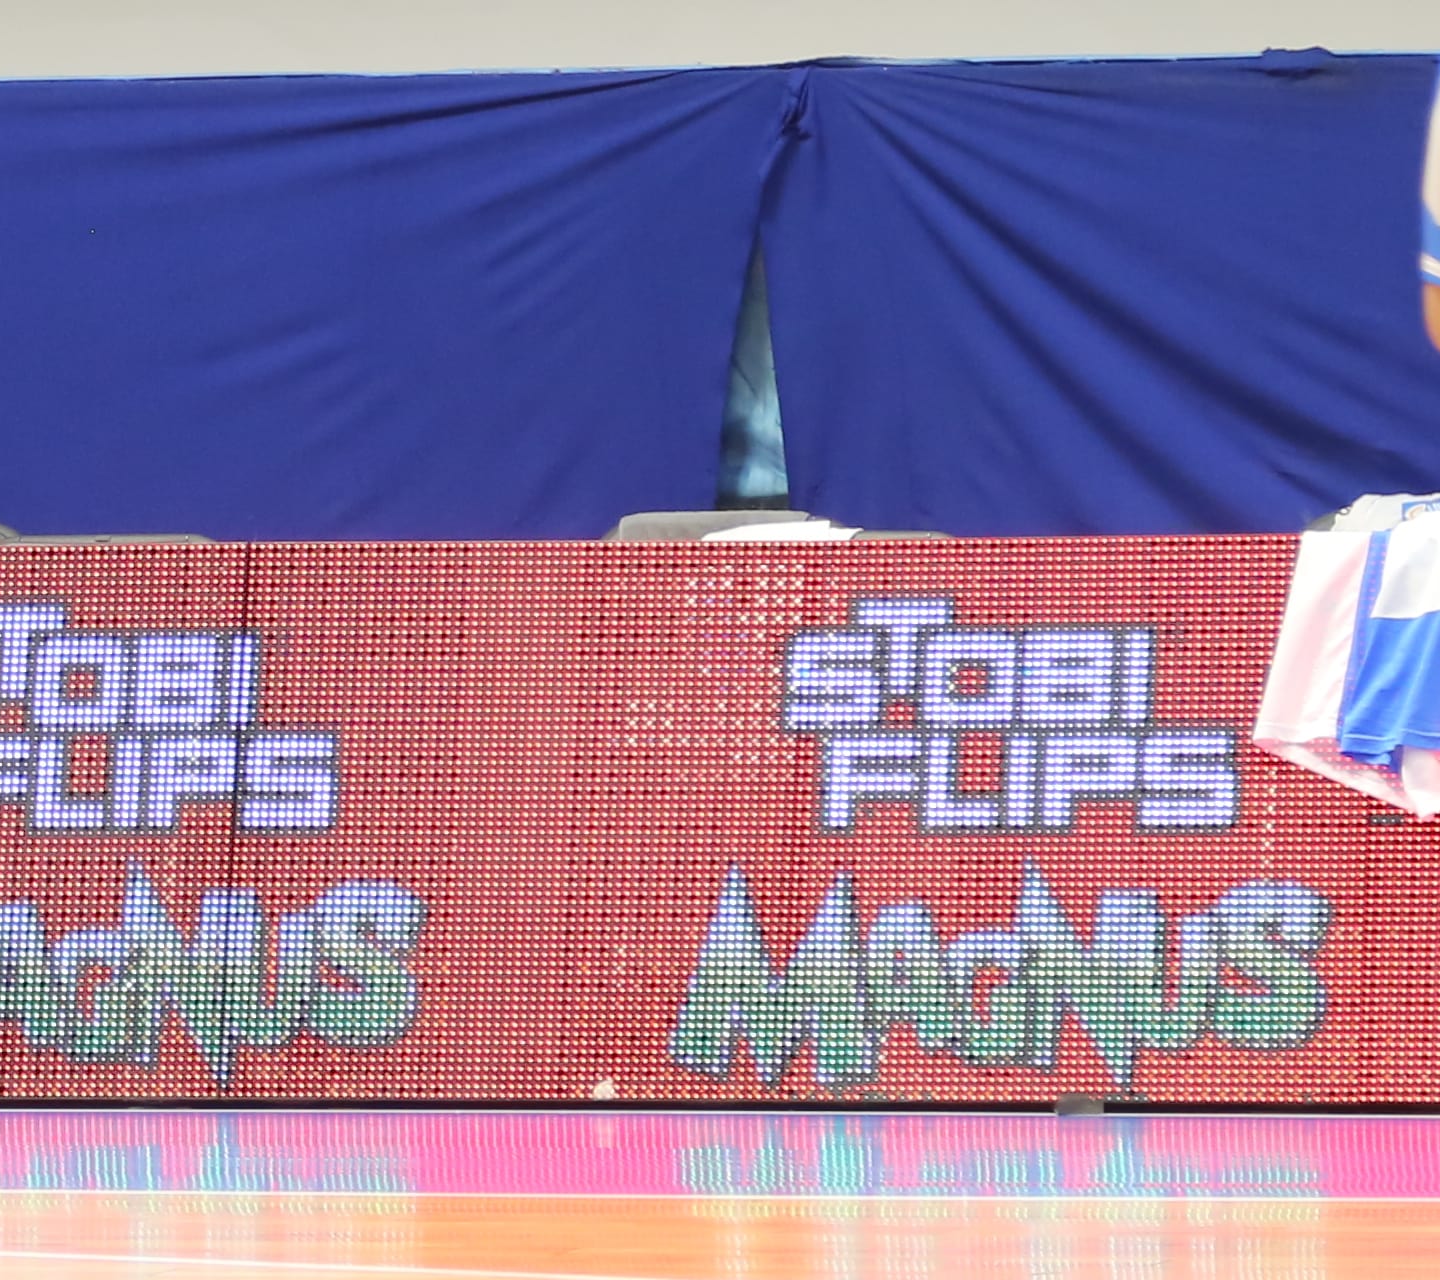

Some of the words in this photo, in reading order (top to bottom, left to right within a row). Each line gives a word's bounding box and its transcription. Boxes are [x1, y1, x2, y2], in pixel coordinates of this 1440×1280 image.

[782, 597, 1156, 734] STOBI
[818, 727, 1241, 834] FLIPS
[670, 861, 1335, 1091] MAGNUS
